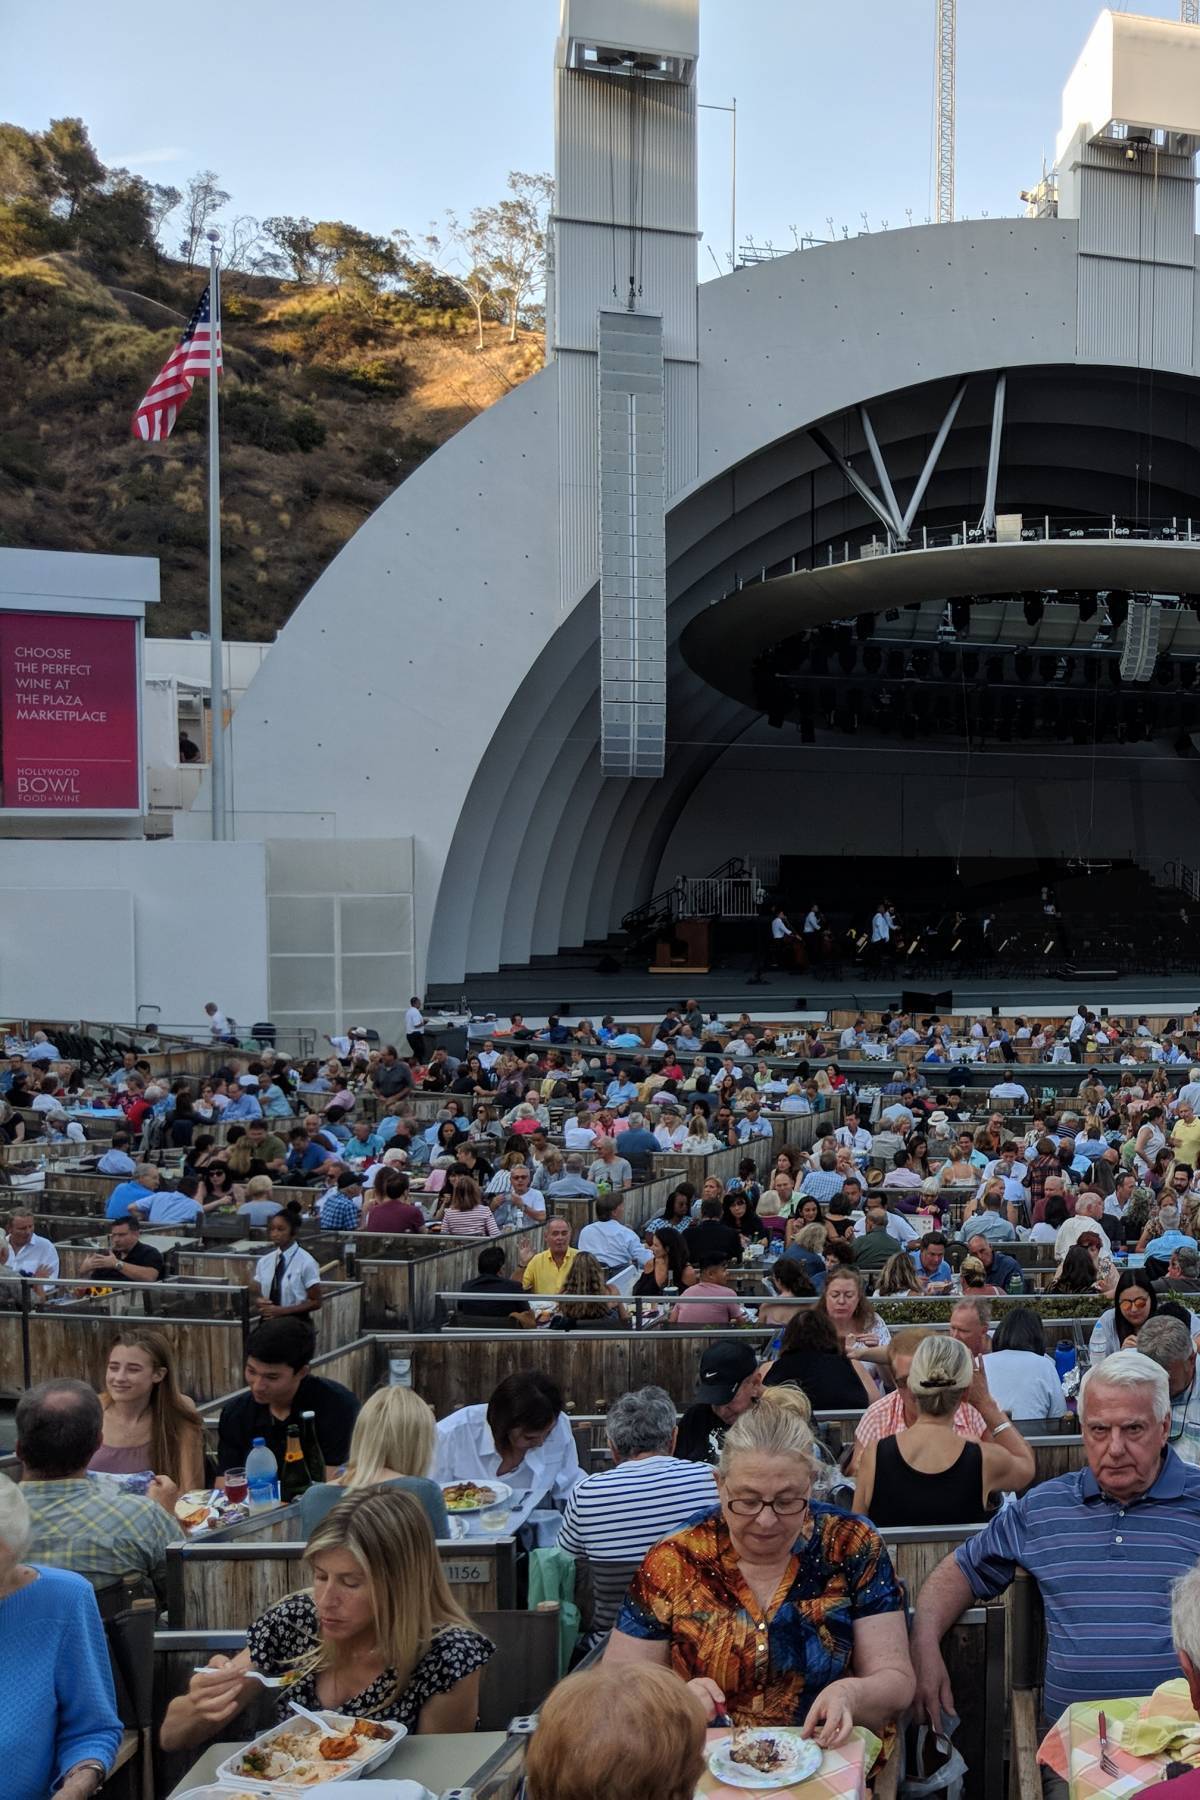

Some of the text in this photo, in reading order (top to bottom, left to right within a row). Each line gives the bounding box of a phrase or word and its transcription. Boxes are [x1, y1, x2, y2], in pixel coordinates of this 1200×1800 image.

[15, 646, 72, 660] CHOOSE
[15, 662, 92, 676] THE PERFECT
[16, 678, 71, 690] WINE AT
[16, 693, 84, 706] THE PLAZA
[17, 709, 108, 722] MARKETPLACE
[17, 767, 81, 776] HOLLYWOOD
[17, 777, 81, 793] BOWL
[18, 793, 47, 802] FOOD
[54, 794, 80, 802] WINE
[448, 1566, 480, 1580] 1156
